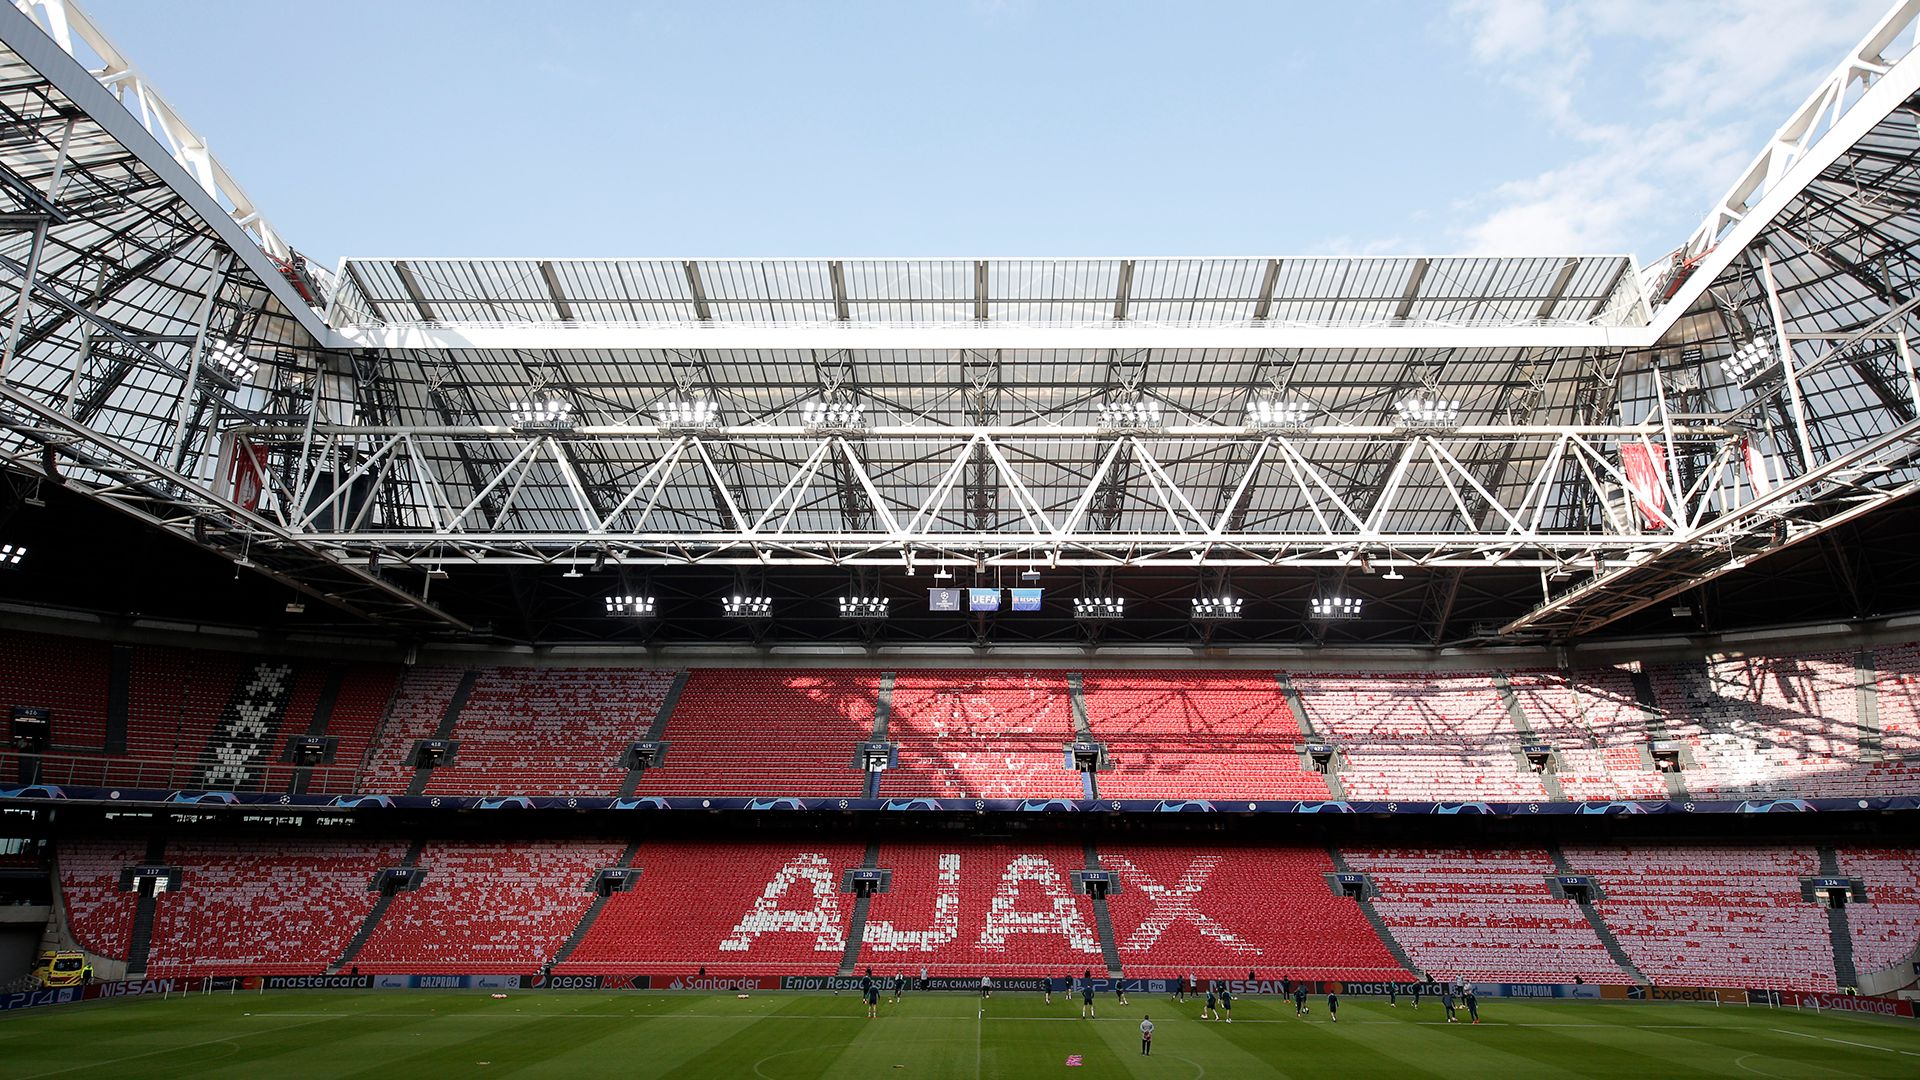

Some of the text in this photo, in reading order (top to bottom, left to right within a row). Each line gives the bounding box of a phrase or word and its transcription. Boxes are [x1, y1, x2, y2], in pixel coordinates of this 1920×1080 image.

[972, 595, 997, 603] UEFA
[719, 853, 1263, 953] AJAX
[100, 979, 175, 998] NISSAN
[270, 976, 367, 988] mastercard
[420, 976, 460, 988] GAZPROM
[552, 975, 637, 990] pepsi MAX
[686, 975, 761, 990] Santander
[785, 976, 907, 991] Enjoy Respsiby
[950, 980, 1001, 989] CHAMPNS
[1004, 980, 1037, 989] LEAGUE
[1092, 979, 1163, 992] P4 Pro
[1511, 984, 1553, 997] GAZPROM
[8, 990, 54, 1008] PS4
[1821, 993, 1897, 1016] Santander
